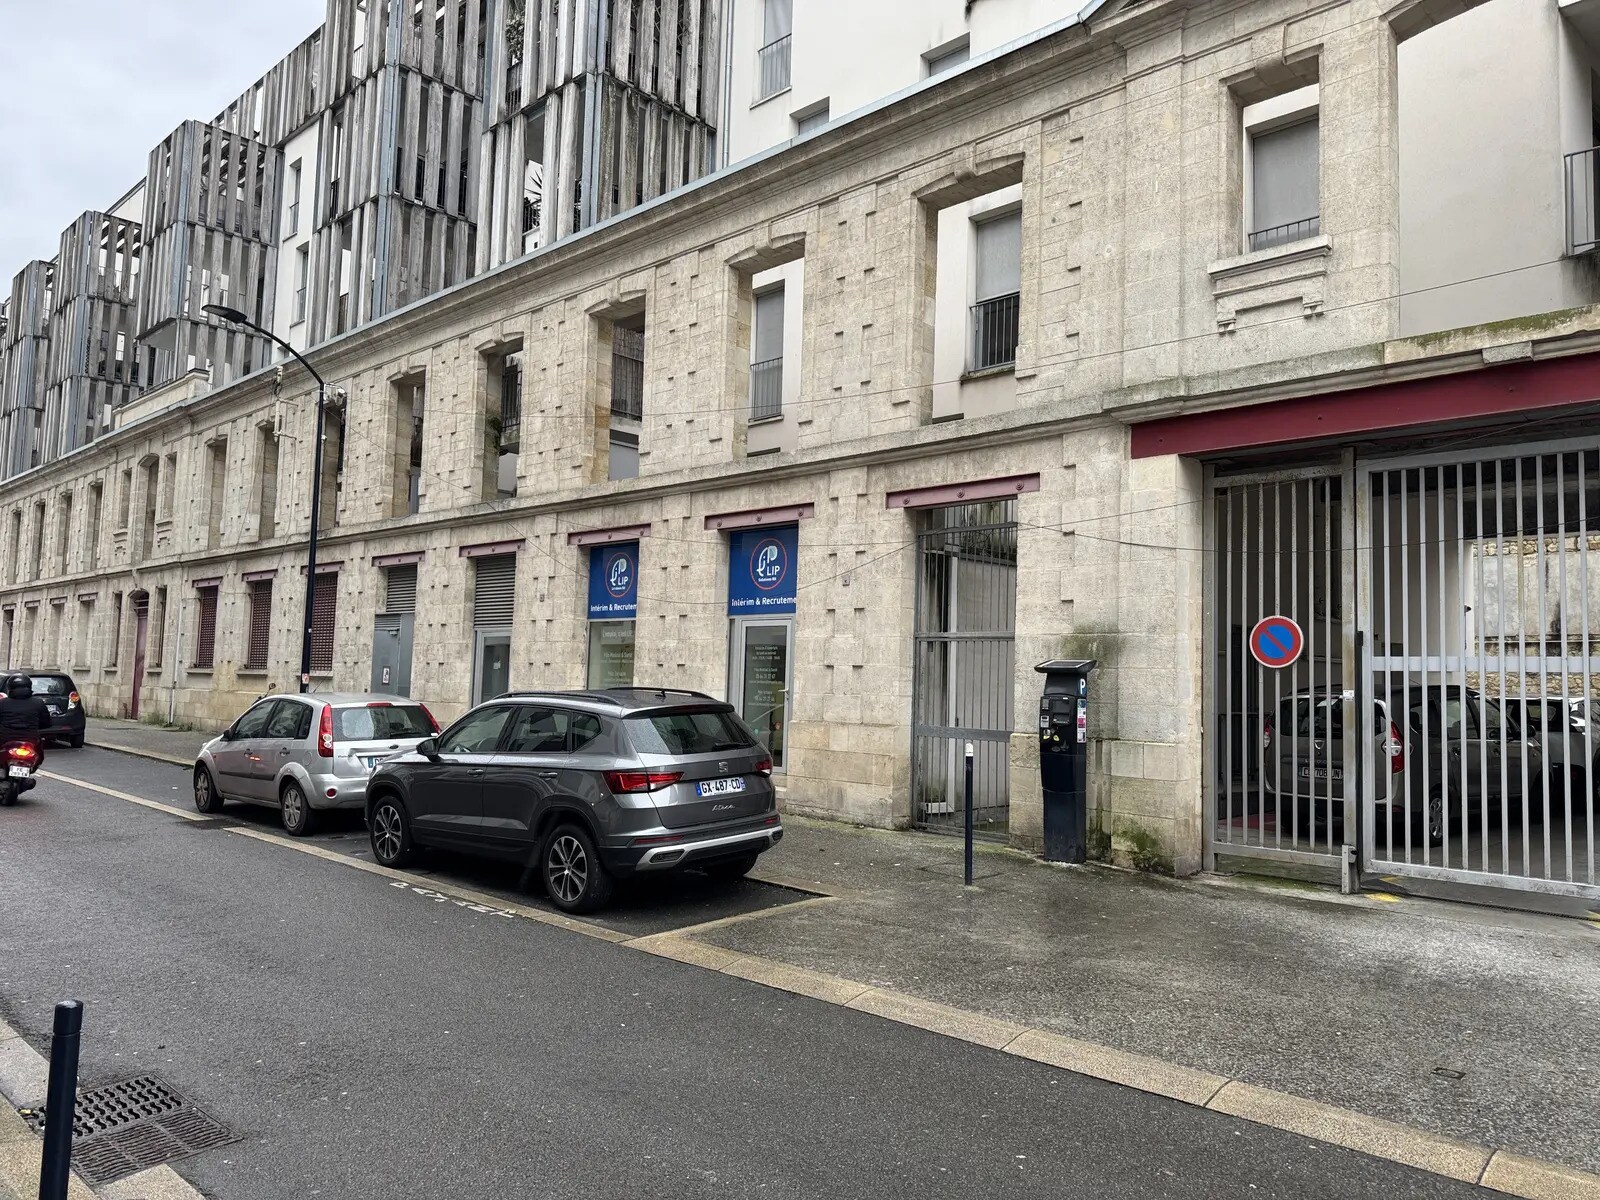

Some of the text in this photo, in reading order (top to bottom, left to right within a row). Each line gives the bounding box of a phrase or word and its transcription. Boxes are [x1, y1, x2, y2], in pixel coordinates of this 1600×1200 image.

[766, 565, 780, 576] LIP
[618, 576, 629, 585] LIP
[590, 603, 608, 611] Intérim
[609, 603, 613, 611] &
[731, 597, 755, 607] Intérim
[755, 597, 761, 606] &
[1080, 678, 1086, 694] P
[701, 779, 741, 793] GX-487-CD
